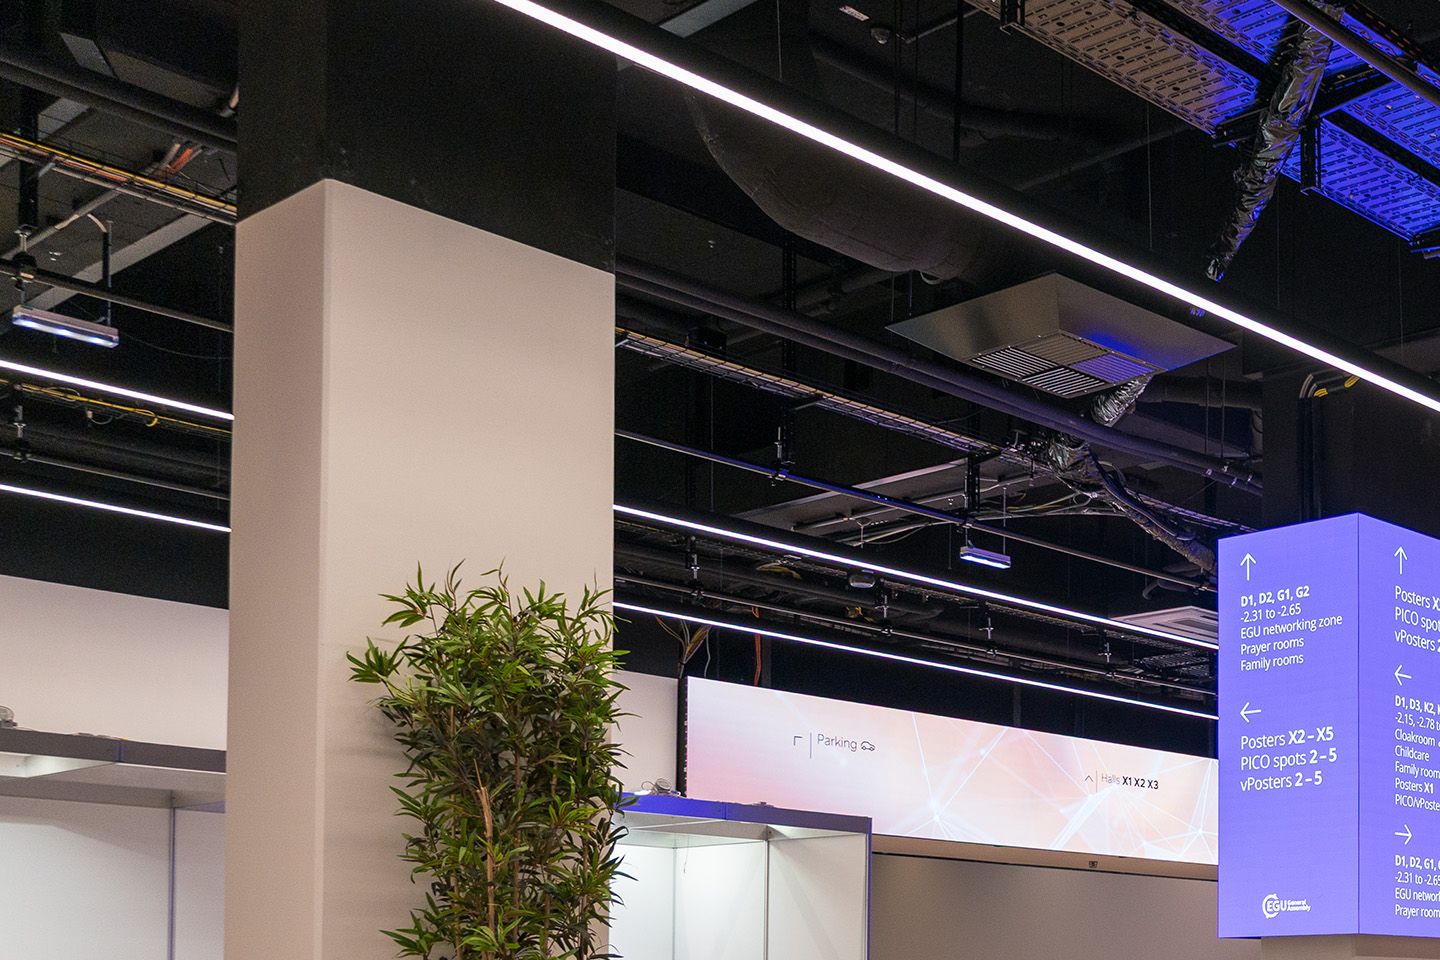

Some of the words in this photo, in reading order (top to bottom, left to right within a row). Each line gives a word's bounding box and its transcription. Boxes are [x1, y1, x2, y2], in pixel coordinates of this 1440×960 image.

[1241, 594, 1257, 607] D1,
[1259, 591, 1275, 604] D2,
[1277, 588, 1293, 601] G1,
[1296, 585, 1310, 598] G2
[1395, 585, 1431, 609] Posters
[1240, 609, 1262, 623] -2.31
[1265, 608, 1276, 620] to
[1278, 602, 1302, 617] -2.65
[1395, 606, 1419, 626] PICO
[1240, 625, 1261, 639] EGU
[1263, 618, 1317, 632] networking
[1319, 615, 1343, 628] zone
[1240, 642, 1271, 656] Prayer
[1273, 637, 1304, 651] rooms
[1394, 629, 1436, 652] vPosters
[1240, 657, 1271, 671] Family
[1273, 654, 1304, 667] rooms
[1395, 695, 1409, 710] D1,
[1409, 698, 1423, 713] D3,
[1424, 701, 1436, 716] K2,
[1417, 716, 1435, 730] -2.78
[817, 733, 858, 753] Parking
[1241, 734, 1286, 750] Posters
[1395, 728, 1436, 747] Cloakroom
[1241, 754, 1271, 771] PICO
[1273, 752, 1307, 771] spots
[1395, 745, 1430, 761] Childcare
[1395, 760, 1419, 778] Family
[1101, 772, 1121, 785] Halls
[1122, 775, 1132, 786] X1
[1134, 777, 1146, 788] X2
[1147, 779, 1159, 790] X3
[1240, 775, 1293, 792] vPosters
[1395, 777, 1423, 792] Posters
[1424, 781, 1434, 794] X1
[1395, 854, 1409, 869] D1,
[1409, 856, 1423, 870] D2,
[1424, 858, 1437, 871] G1,
[1395, 871, 1413, 883] -2.31
[1415, 873, 1423, 885] to
[1395, 887, 1412, 900] EGU
[1395, 904, 1420, 919] Prayer
